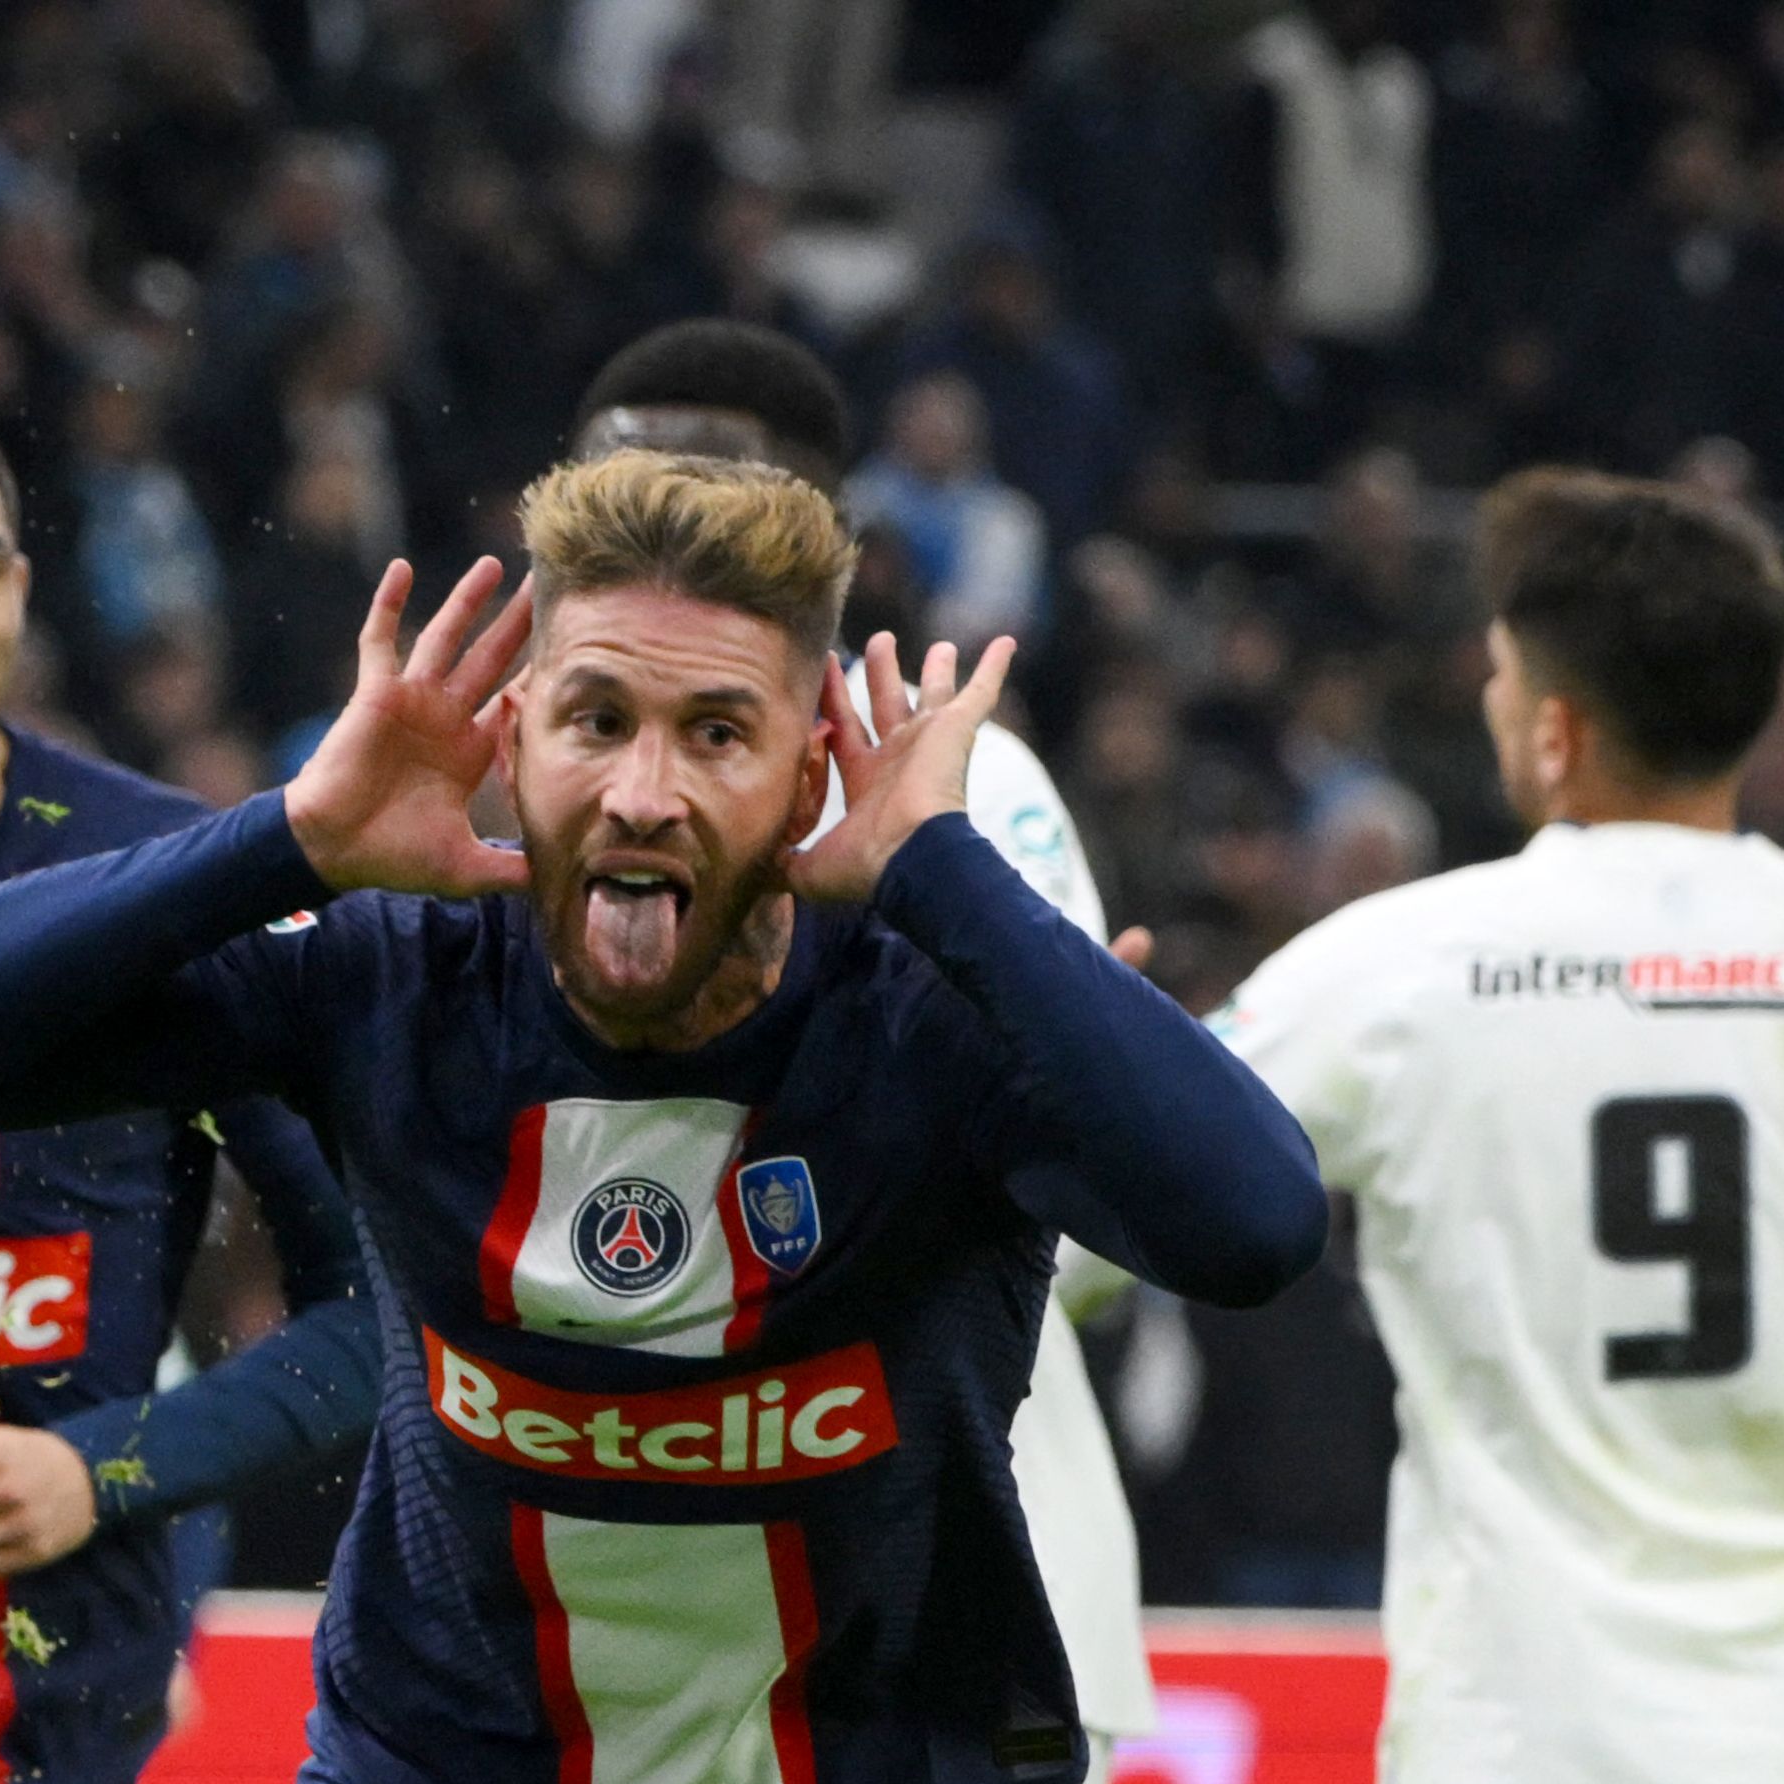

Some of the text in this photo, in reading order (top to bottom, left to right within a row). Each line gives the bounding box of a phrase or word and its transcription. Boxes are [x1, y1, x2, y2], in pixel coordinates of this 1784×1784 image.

[596, 1186, 670, 1217] PARIS
[1592, 1092, 1754, 1382] 9
[770, 1237, 807, 1256] FFF
[439, 1345, 868, 1472] Betclic
